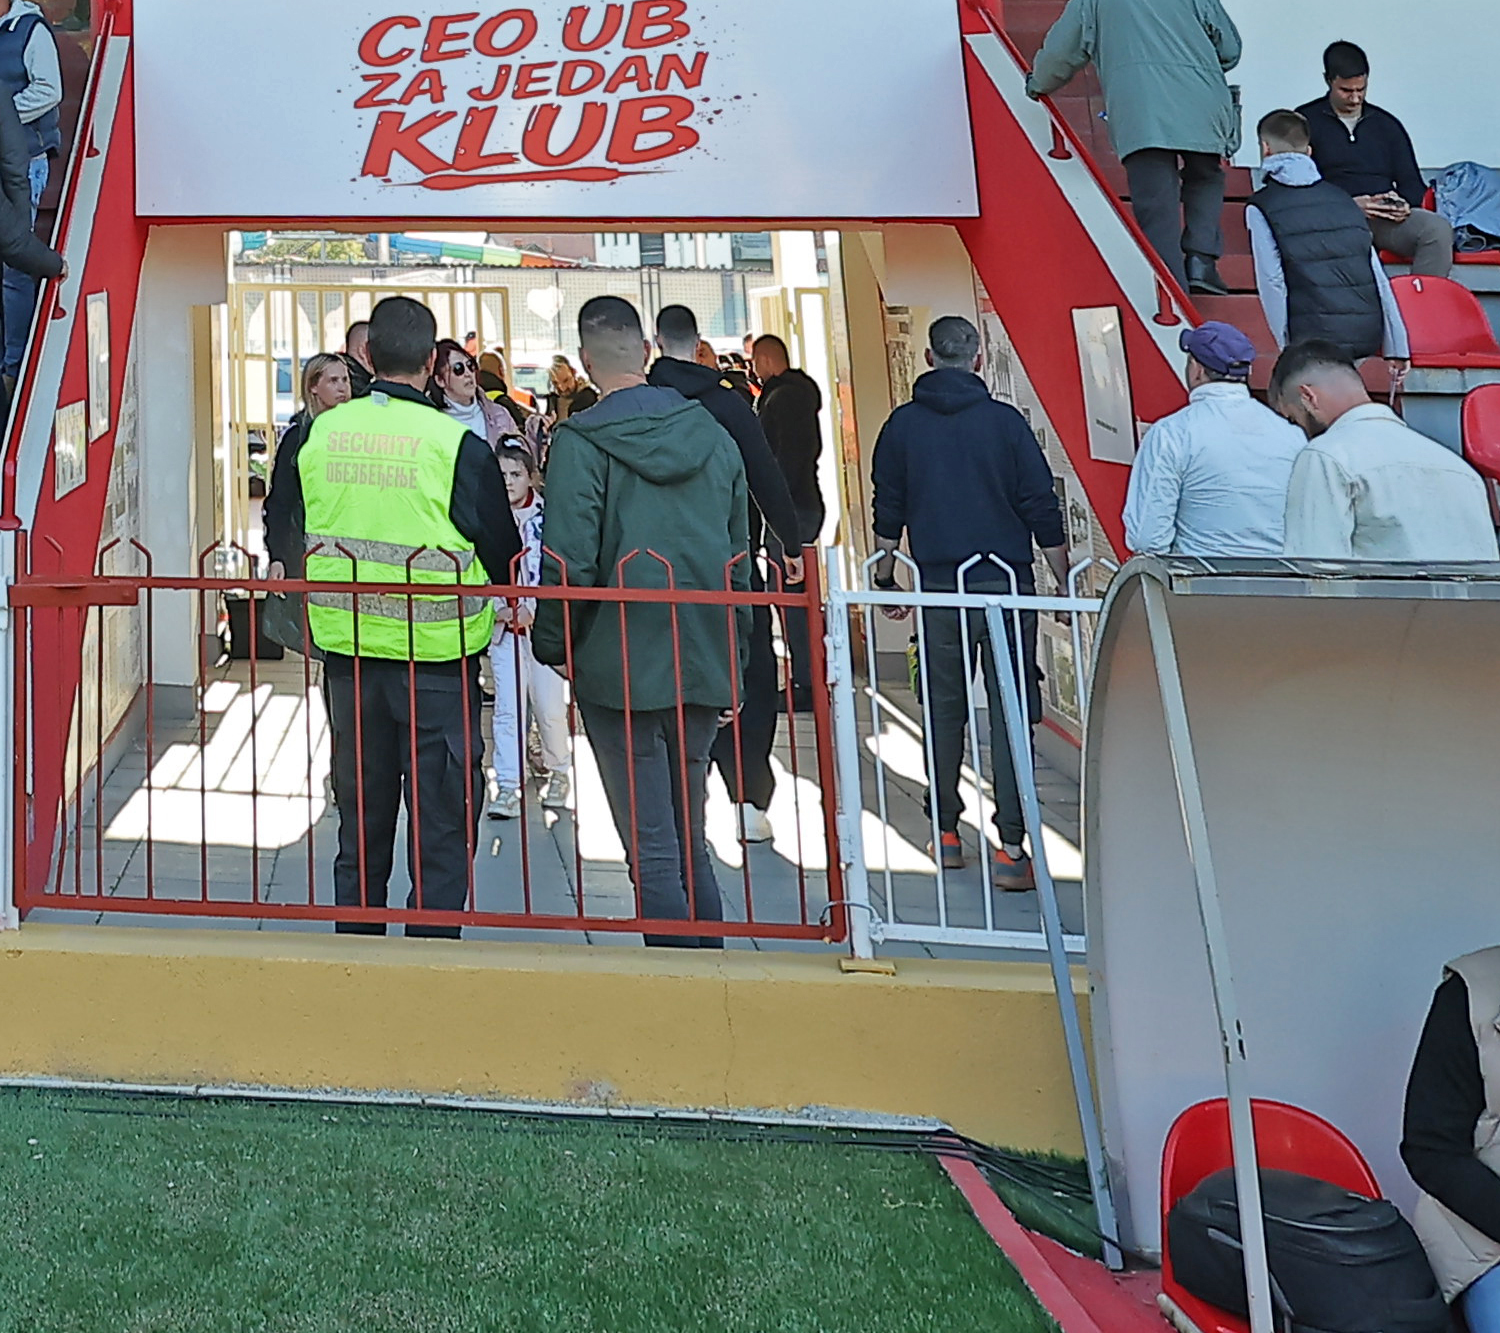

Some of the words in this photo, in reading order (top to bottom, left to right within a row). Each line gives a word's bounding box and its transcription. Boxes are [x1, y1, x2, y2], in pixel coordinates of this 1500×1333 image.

[356, 8, 538, 68] CEO
[353, 68, 447, 110] ZA
[467, 50, 709, 102] JEDAN
[360, 94, 701, 177] KLUB
[1412, 278, 1422, 292] 1
[327, 431, 423, 457] SECURITY
